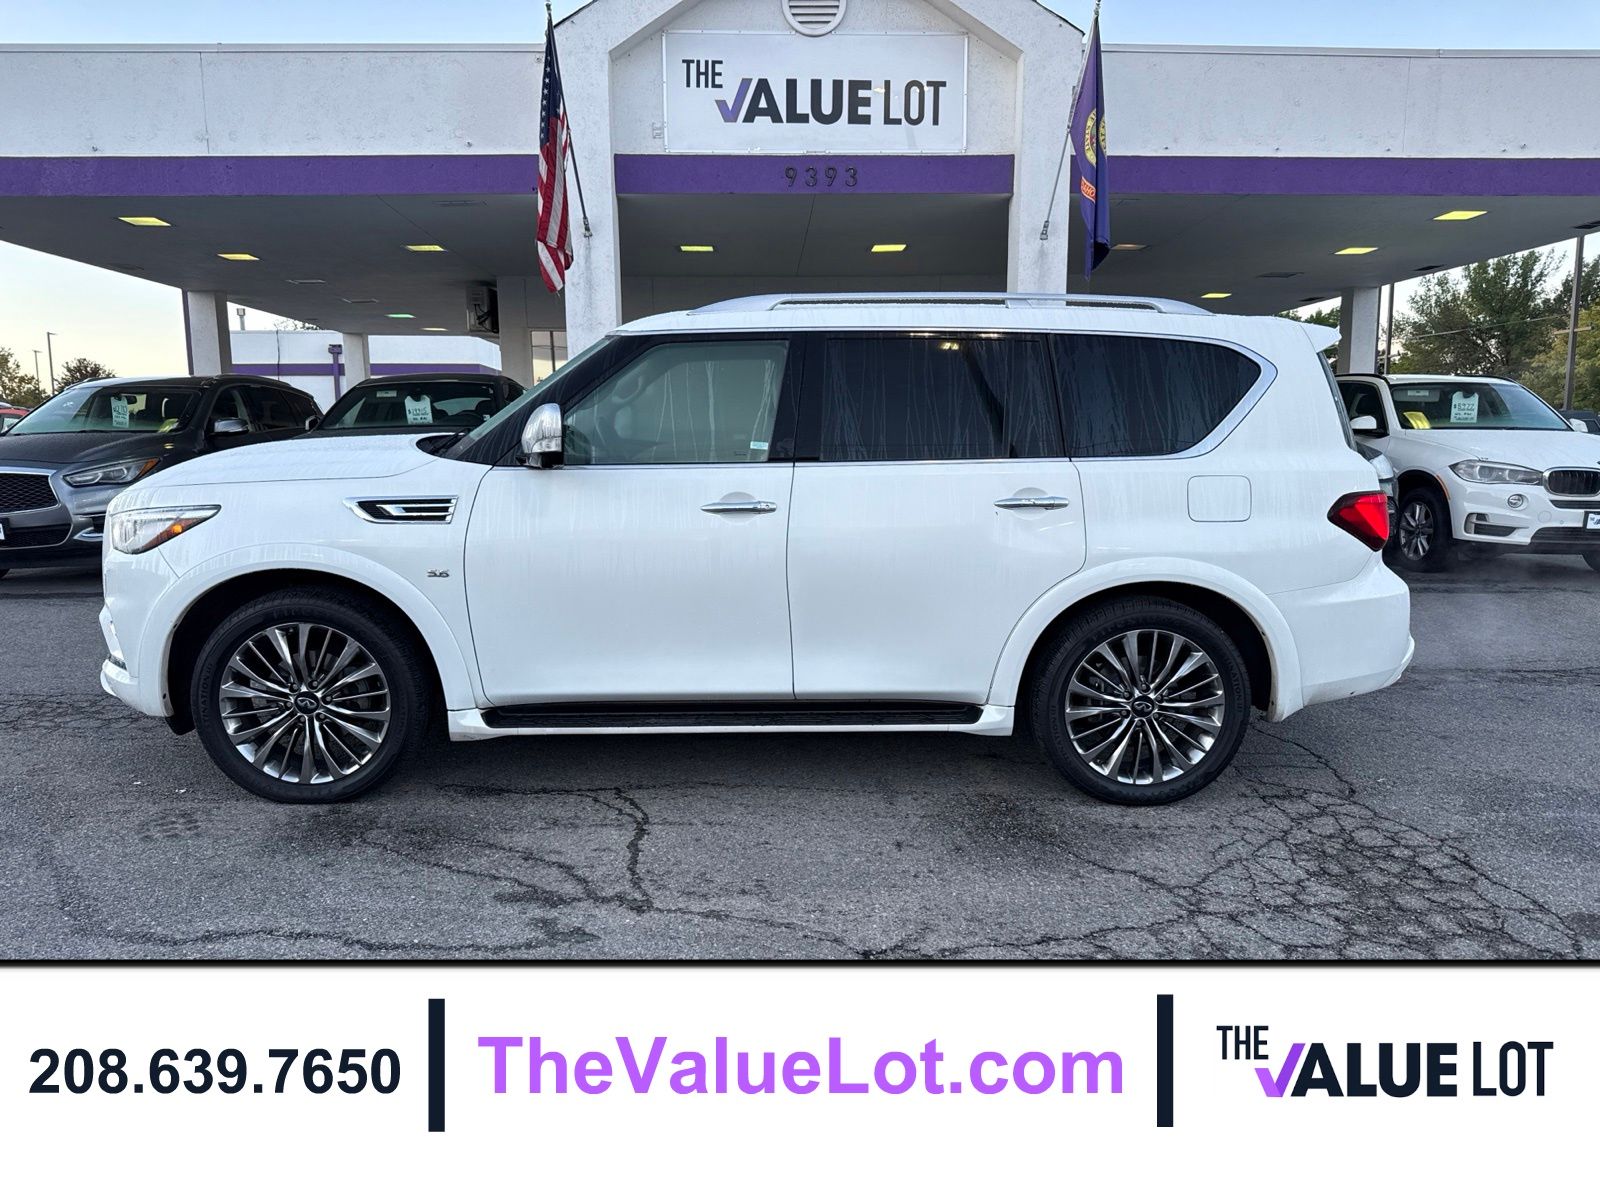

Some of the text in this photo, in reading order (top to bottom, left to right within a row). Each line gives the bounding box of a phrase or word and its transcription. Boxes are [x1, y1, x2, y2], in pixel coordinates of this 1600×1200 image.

[682, 59, 723, 88] THE
[714, 78, 947, 126] VALUE LOT
[785, 167, 857, 187] 9393
